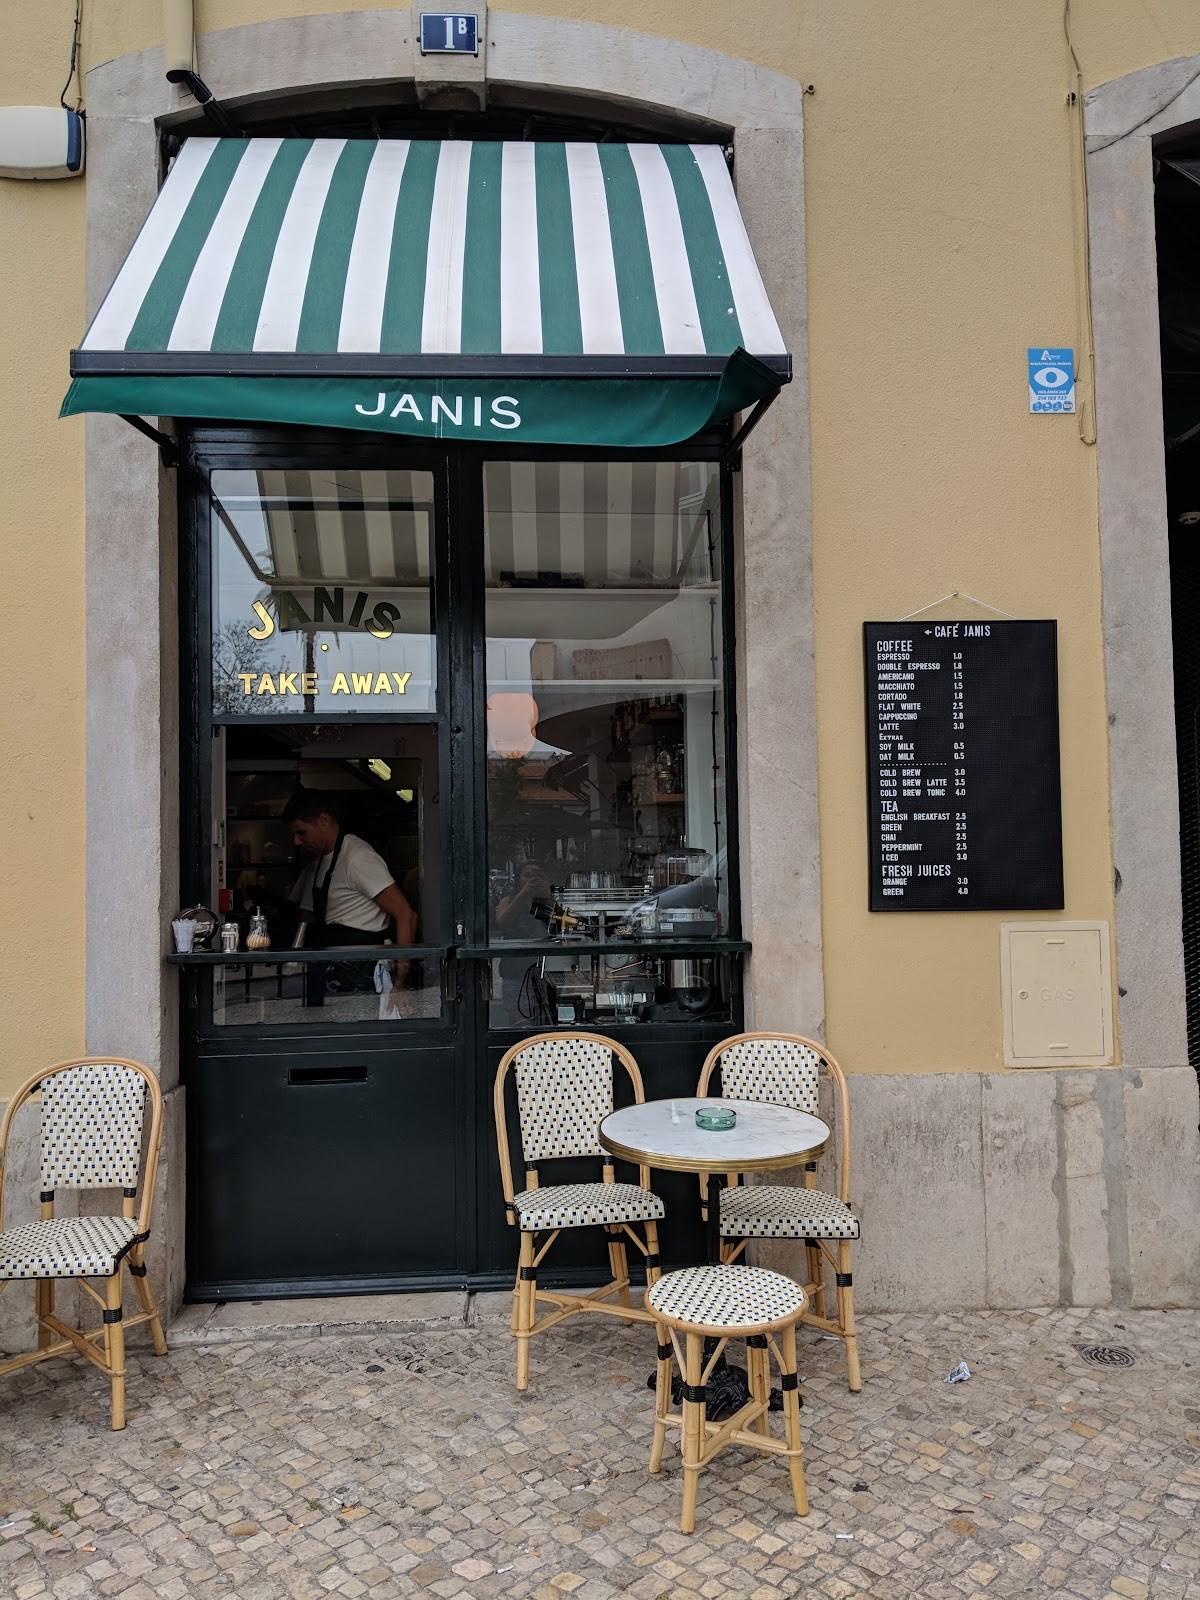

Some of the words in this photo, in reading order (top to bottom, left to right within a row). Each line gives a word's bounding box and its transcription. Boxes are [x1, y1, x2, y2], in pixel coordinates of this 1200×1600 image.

[354, 392, 522, 430] JANIS
[247, 586, 402, 641] JANIS
[934, 623, 960, 638] CAFÉ
[963, 625, 991, 638] JANIS
[876, 640, 913, 653] COFFEE
[877, 653, 911, 661] ESPRESSO
[952, 652, 963, 660] 1.0
[877, 663, 903, 671] DOUBLE
[907, 663, 941, 671] ESPRESSO
[953, 662, 963, 670] 1.8
[877, 673, 915, 681] AMERICANO
[953, 672, 963, 680] 1.5
[237, 672, 319, 696] TAKE
[330, 672, 413, 696] AWAY
[877, 683, 915, 691] MACCHIATO
[953, 682, 964, 690] 1.5
[877, 693, 908, 701] CORTADO
[953, 692, 964, 700] 1.8
[878, 703, 895, 711] FLAT
[900, 703, 922, 711] WHITE
[952, 702, 964, 710] 2.5
[878, 713, 918, 721] CAPPUCCINO
[952, 712, 964, 720] 2.8
[878, 723, 900, 731] LATTE
[952, 722, 965, 730] 3.0
[878, 743, 893, 751] SOY
[897, 743, 915, 751] MILK
[953, 742, 965, 750] 0.5
[879, 753, 893, 761] OAT
[897, 753, 915, 761] MILK
[953, 752, 965, 760] 0.5
[879, 769, 897, 777] COLD
[901, 769, 922, 777] BREW
[954, 769, 966, 777] 3.0
[879, 779, 898, 787] COLD
[902, 779, 922, 787] BREW
[926, 779, 948, 787] LATTE
[954, 779, 966, 787] 3.5
[879, 789, 898, 797] COLD
[902, 789, 922, 797] BREW
[926, 789, 946, 797] TONIC
[955, 789, 966, 797] 4.0
[880, 801, 899, 813] TEA
[880, 814, 908, 822] ENGLISH
[913, 813, 951, 821] BREAKFAST
[955, 813, 967, 821] 2.5
[880, 824, 903, 832] GREEN
[955, 823, 967, 831] 2.5
[880, 834, 897, 842] CHAI
[955, 833, 967, 841] 2.5
[881, 843, 923, 852] PEPPERMINT
[956, 843, 968, 851] 2.5
[956, 853, 968, 861] 3.0
[881, 865, 913, 877] FRESH
[917, 865, 952, 877] JUICES
[882, 878, 908, 886] ORANGE
[956, 877, 969, 885] 3.0
[882, 888, 904, 896] GREEN
[957, 887, 969, 895] 4.0
[1041, 987, 1076, 1002] GAS
